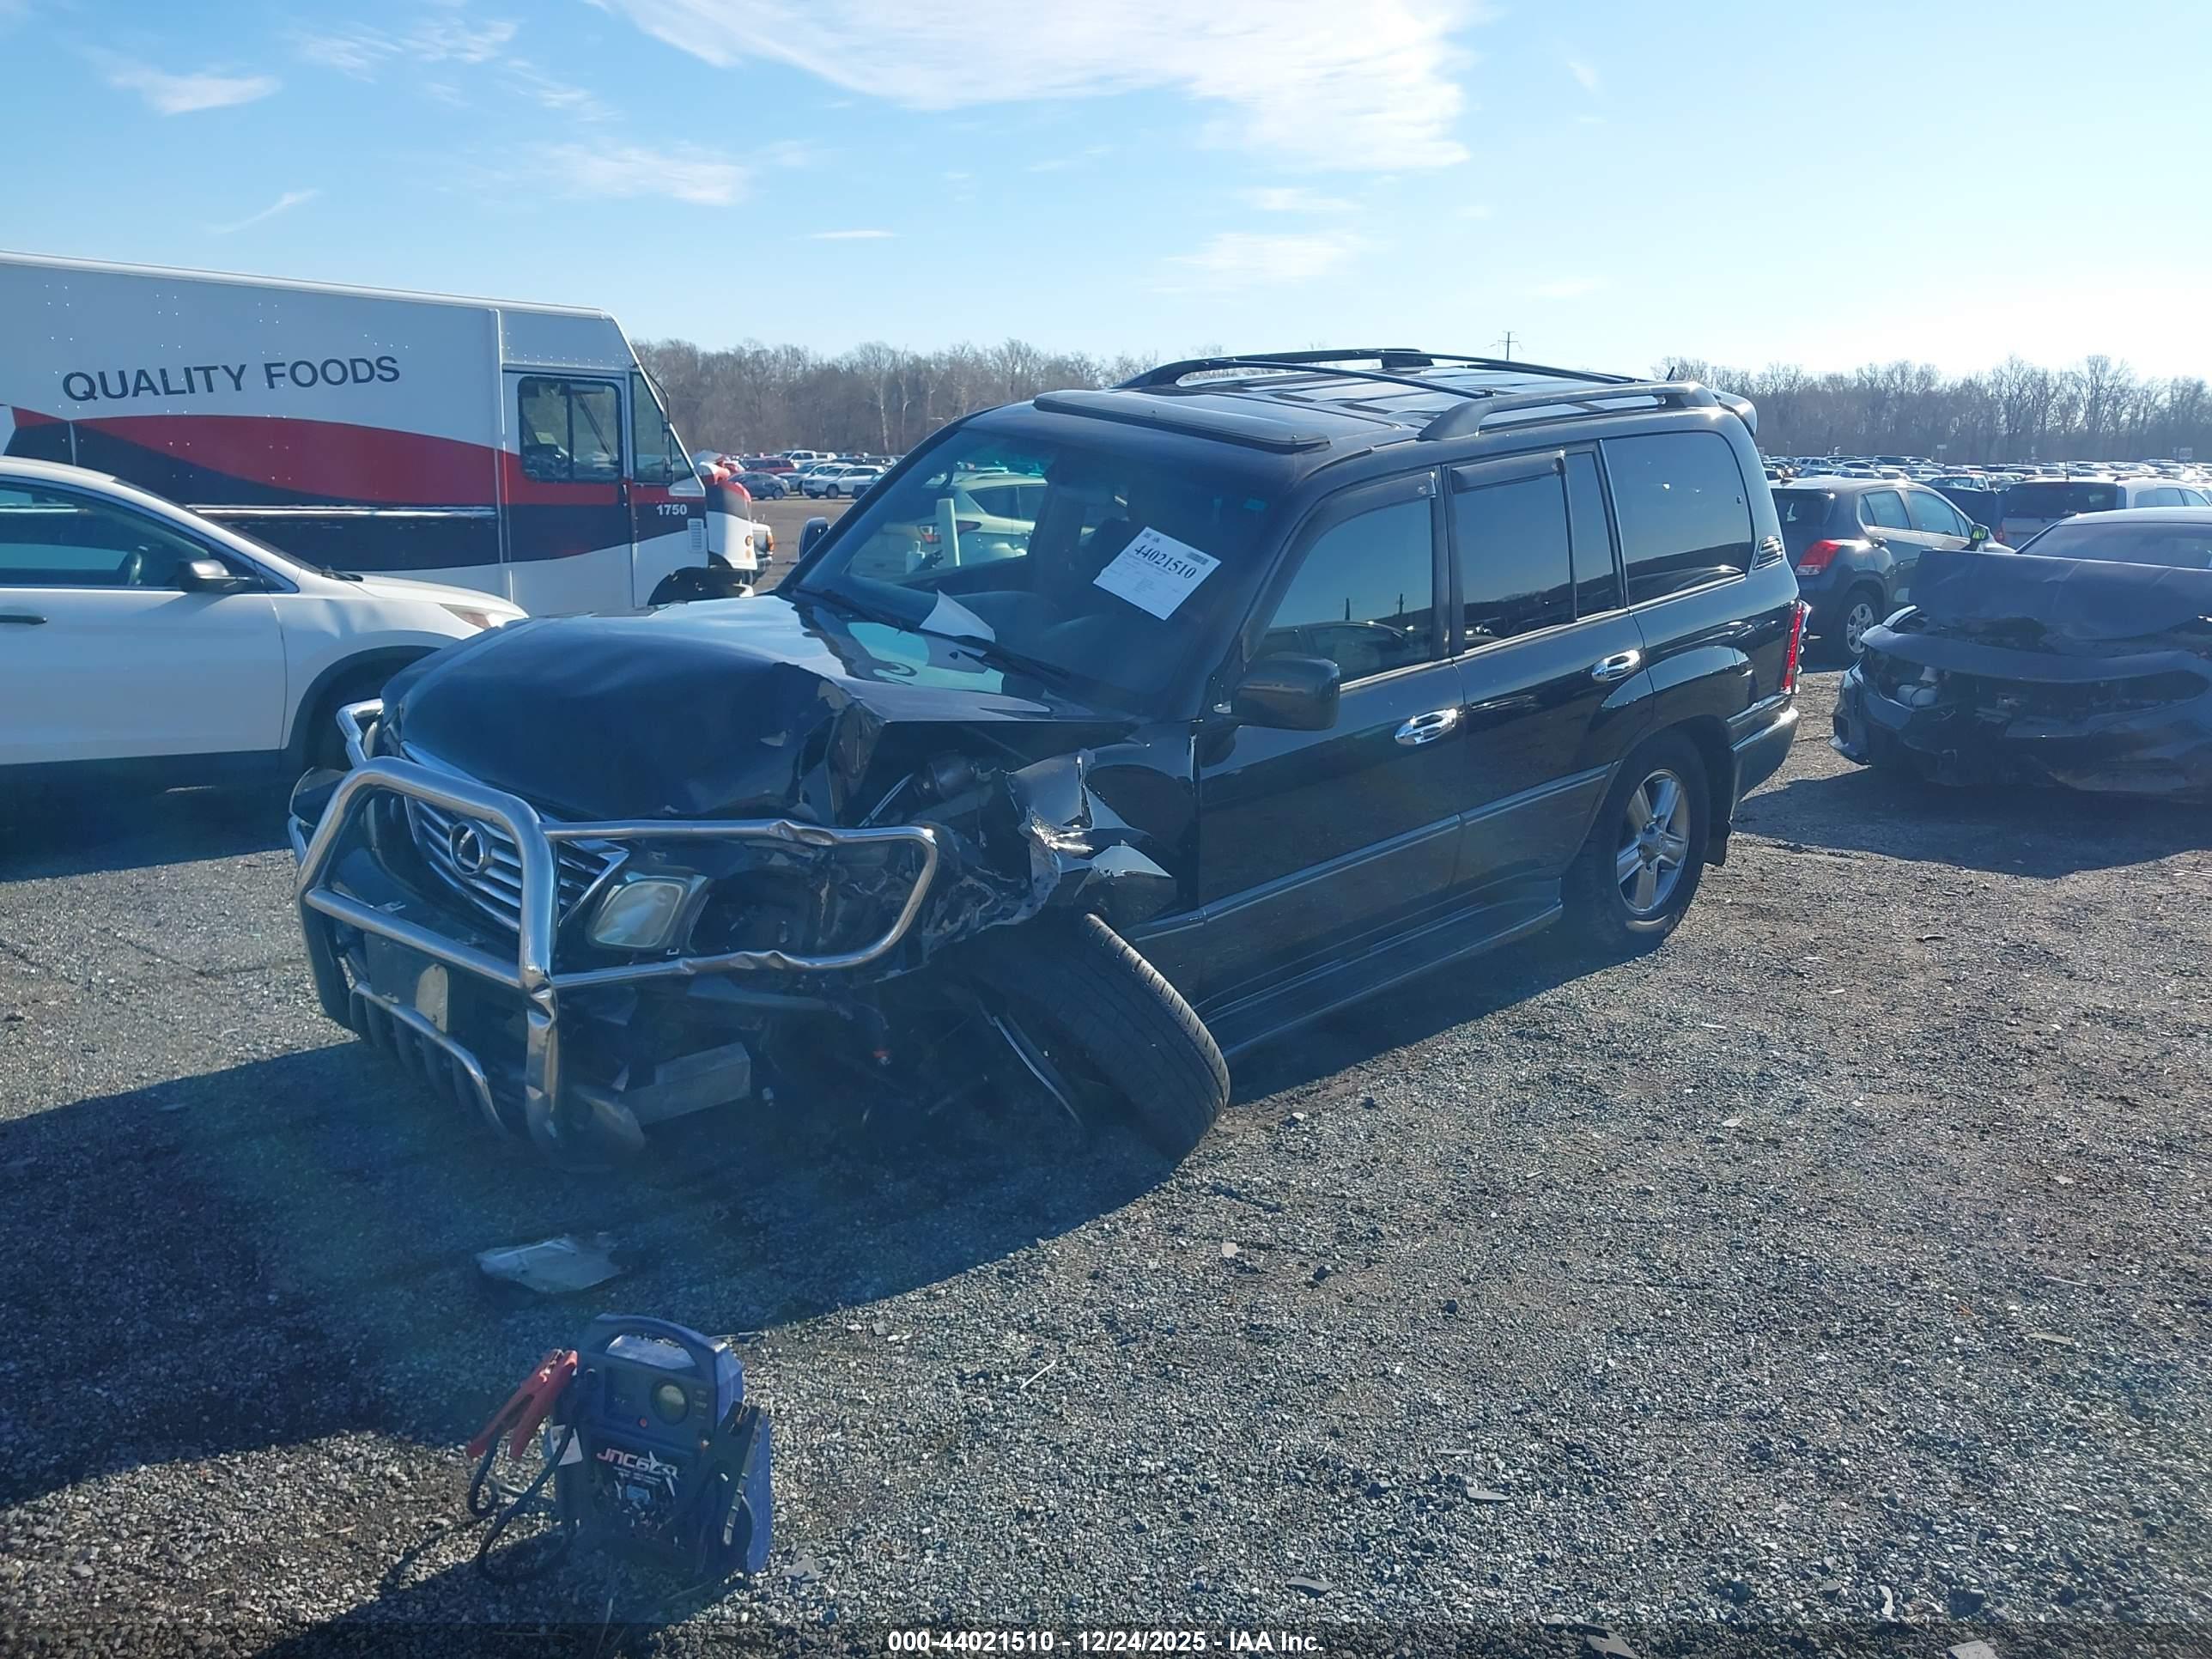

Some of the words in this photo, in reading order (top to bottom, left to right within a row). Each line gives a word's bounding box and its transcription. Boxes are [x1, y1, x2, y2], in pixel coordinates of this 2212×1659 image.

[62, 363, 246, 402] QUALITY
[264, 356, 400, 389] FOODS
[656, 504, 687, 515] 1750
[1134, 544, 1197, 579] 44021510
